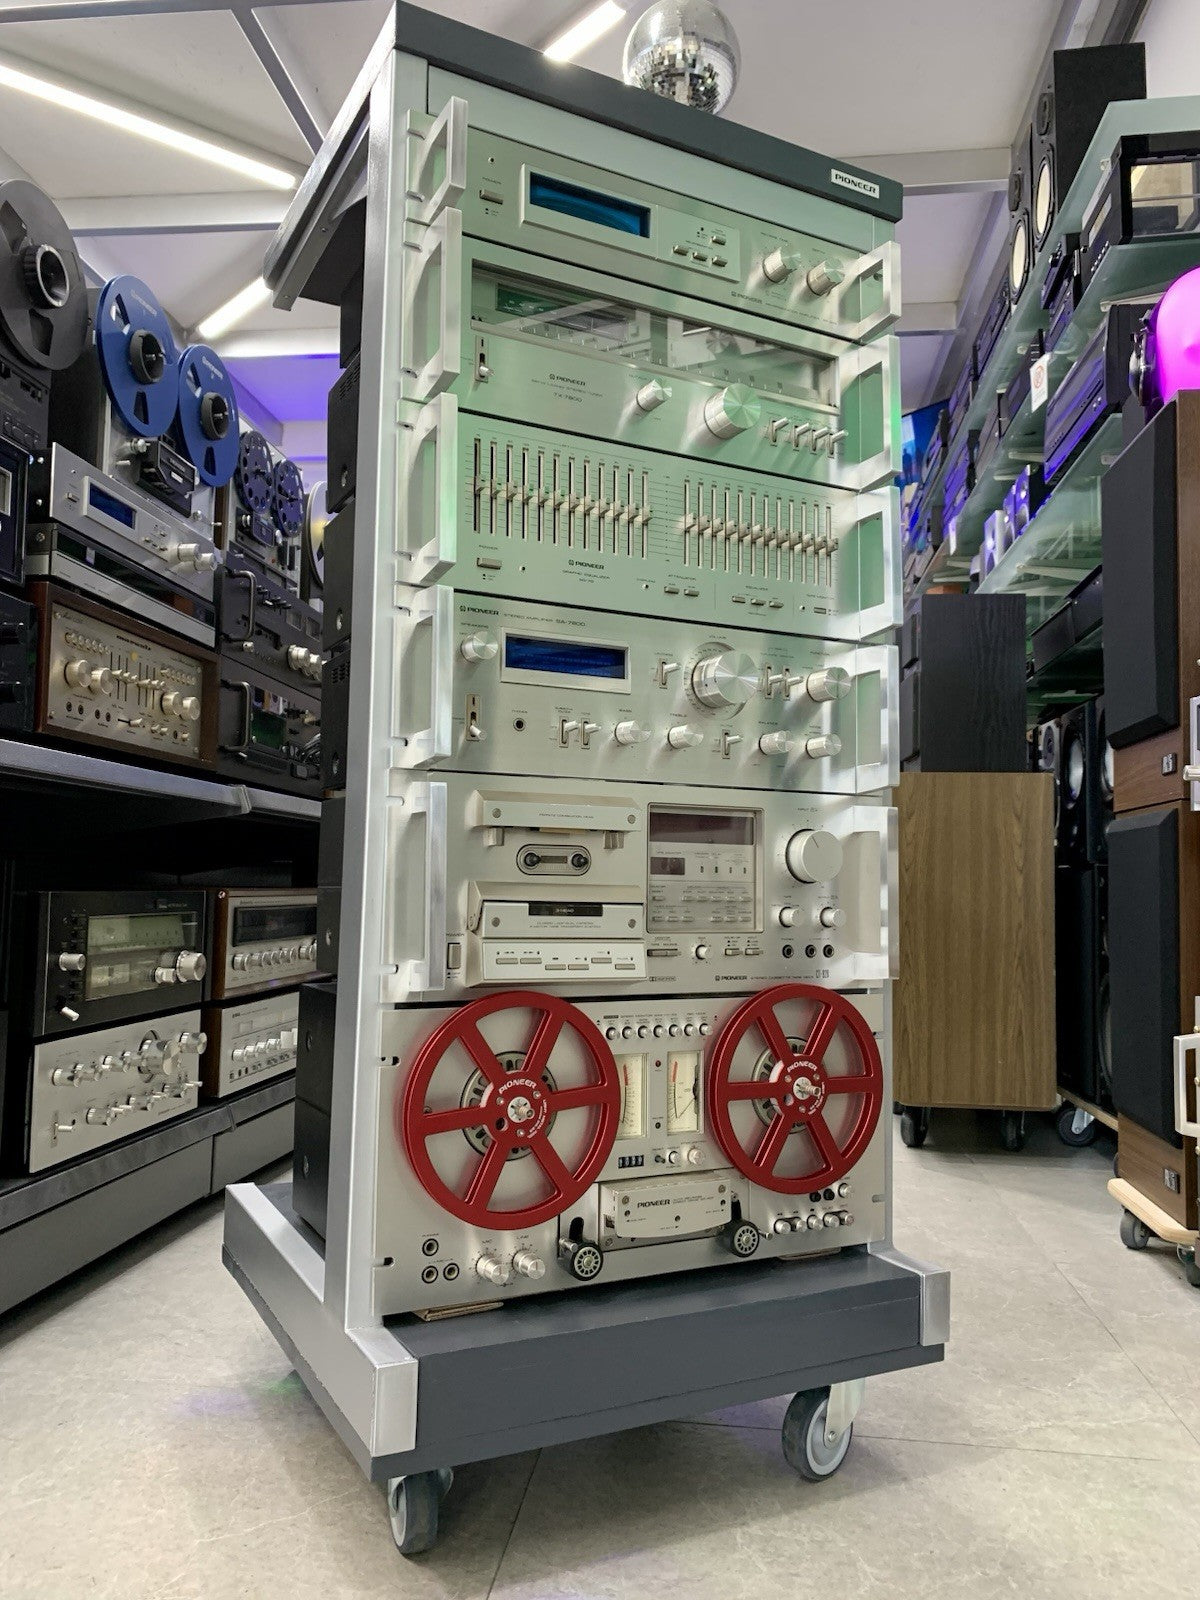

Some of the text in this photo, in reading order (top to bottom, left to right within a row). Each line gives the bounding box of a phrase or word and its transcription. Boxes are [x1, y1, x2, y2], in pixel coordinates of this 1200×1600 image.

[834, 173, 876, 193] PIONEER
[737, 293, 763, 304] PIONEER
[556, 375, 586, 387] PIONEER
[575, 560, 605, 570] PIONEER
[467, 606, 500, 616] PIONEER
[555, 618, 586, 627] SA-7800
[720, 974, 748, 982] PIONEER
[786, 1060, 818, 1073] PIONEER
[498, 1078, 538, 1095] PIONEER
[637, 1198, 671, 1209] PIONEER
